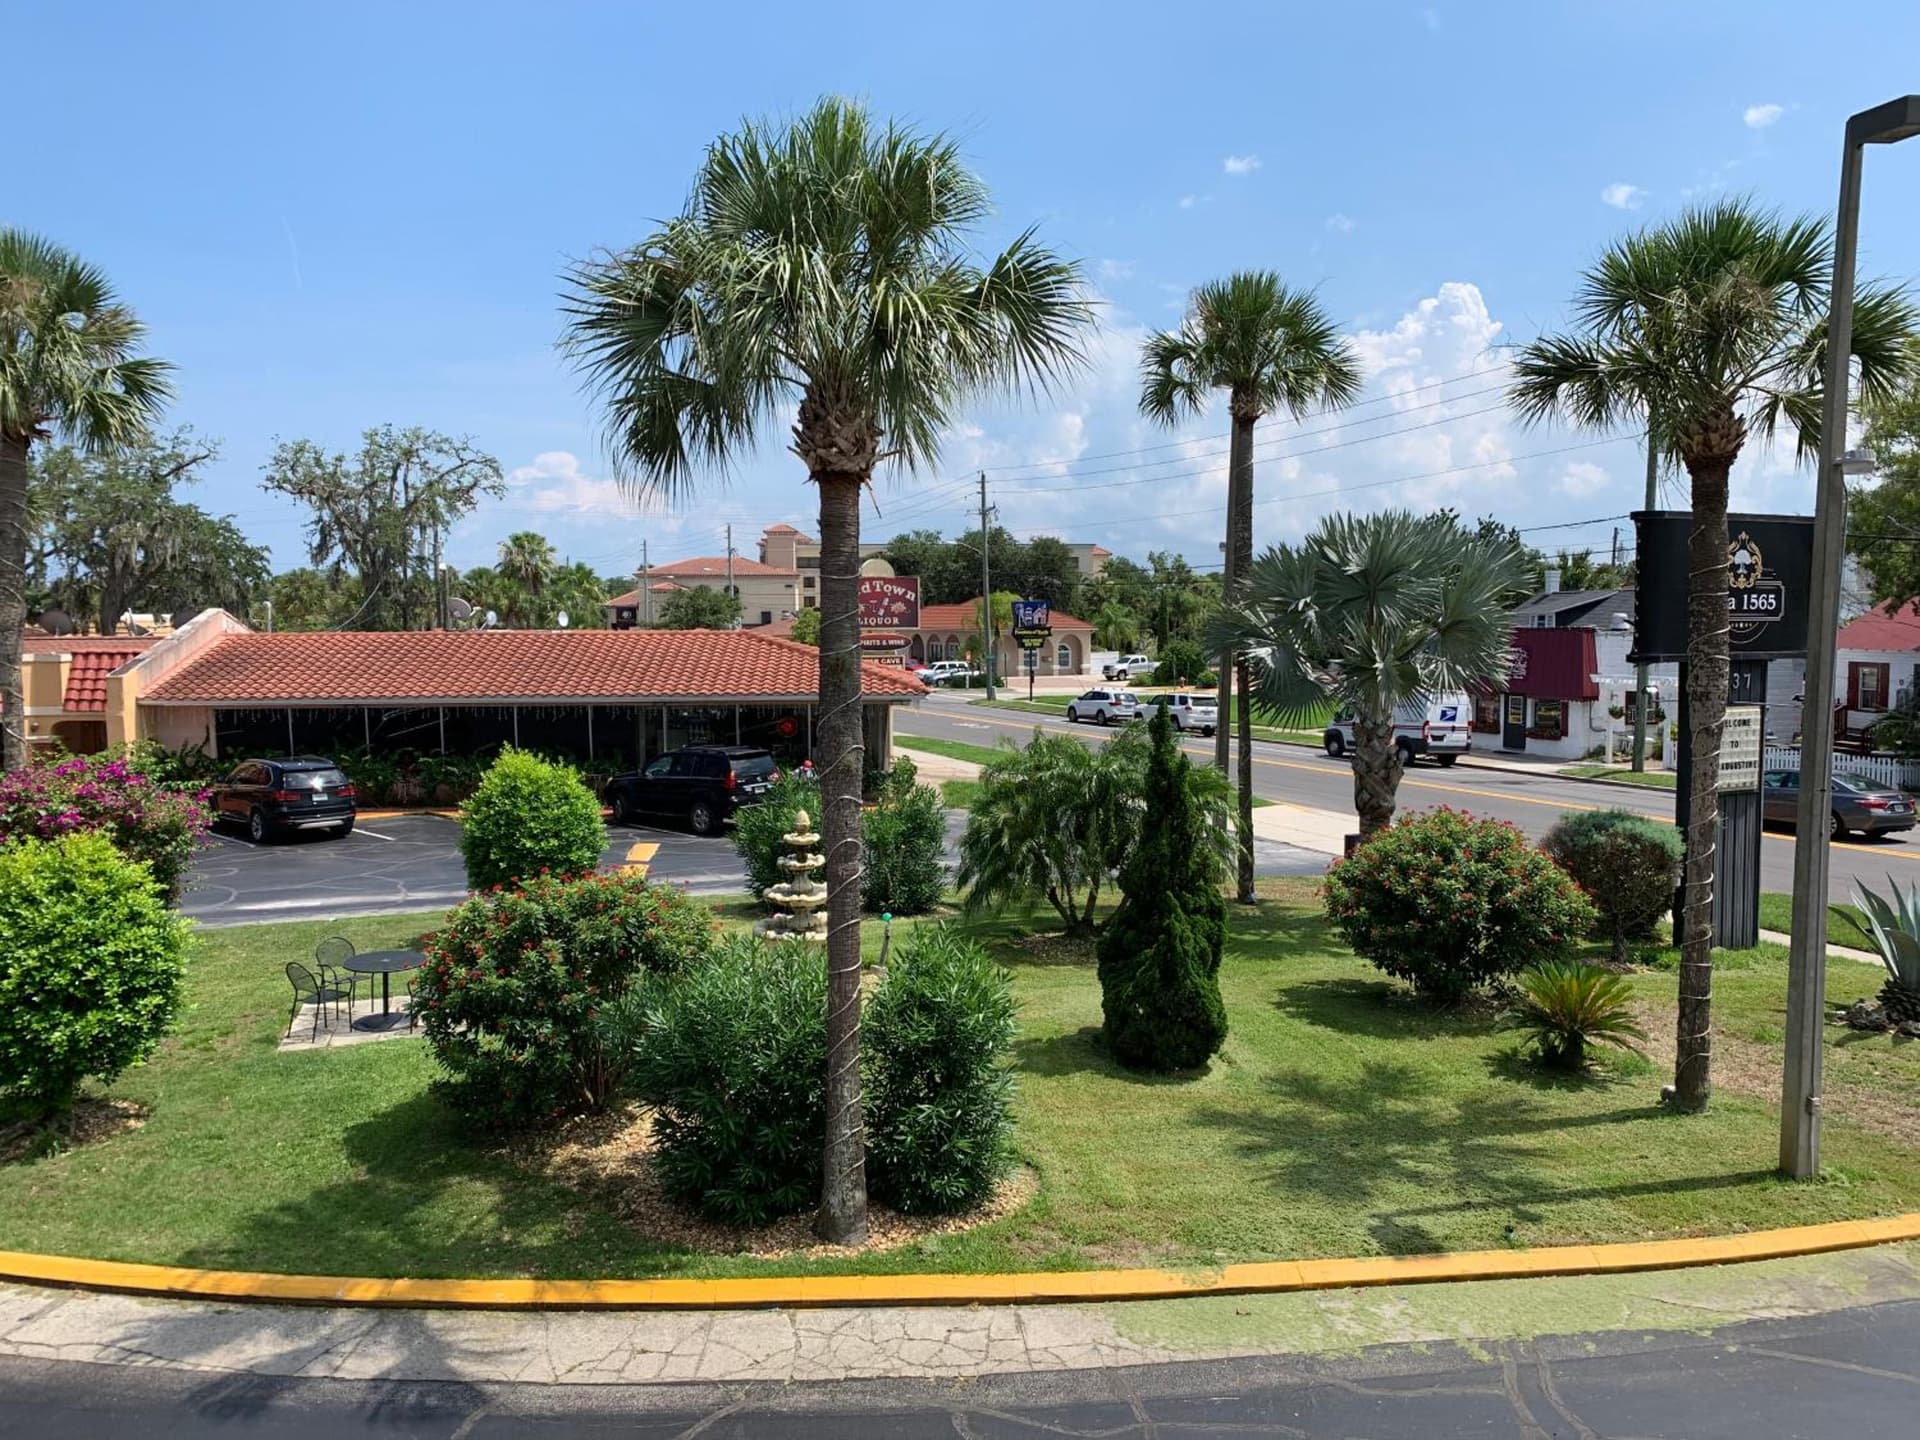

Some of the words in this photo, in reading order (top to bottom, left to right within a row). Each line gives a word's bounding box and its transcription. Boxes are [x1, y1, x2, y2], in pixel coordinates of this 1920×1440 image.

[872, 580, 916, 602] Town
[1743, 594, 1776, 610] 1565
[1724, 718, 1751, 728] ELCOME
[1729, 740, 1739, 749] TO
